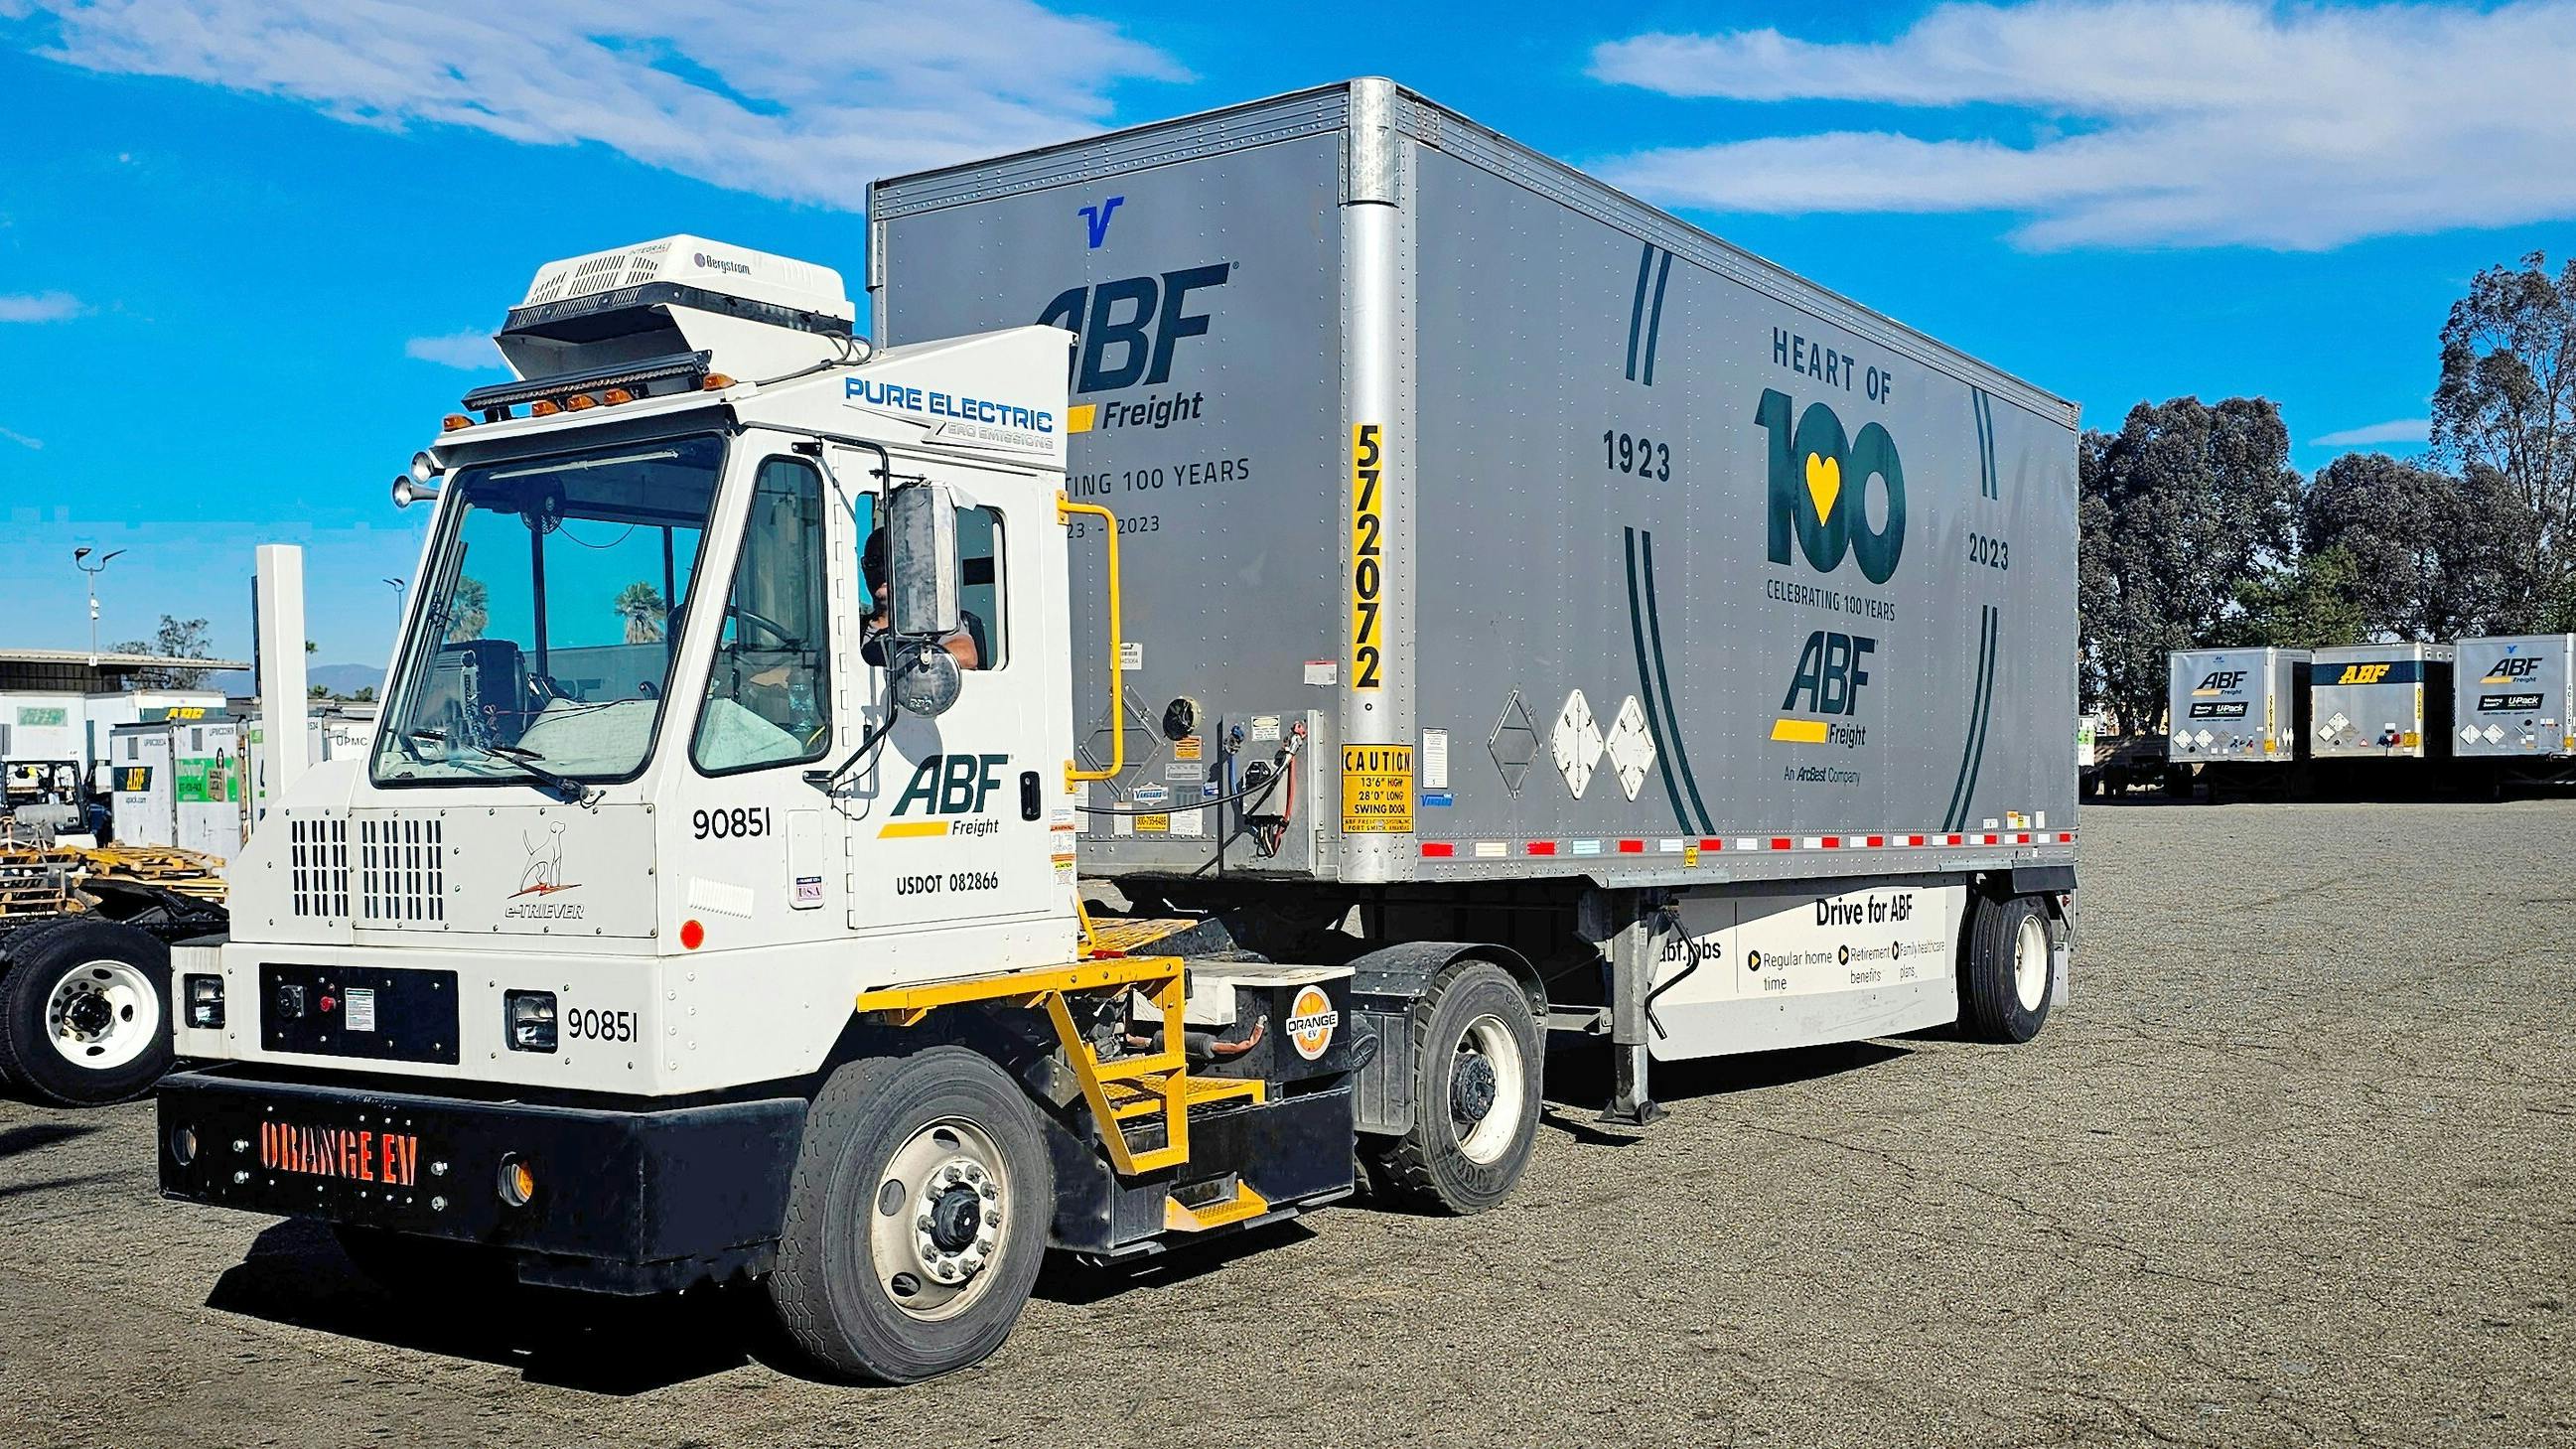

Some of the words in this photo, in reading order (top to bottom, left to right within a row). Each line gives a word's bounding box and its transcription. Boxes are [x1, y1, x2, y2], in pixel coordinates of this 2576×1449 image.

[706, 254, 752, 275] Bergstrom
[1772, 326, 1856, 391] HEART
[1865, 364, 1893, 405] OF
[845, 376, 923, 411] PURE
[929, 391, 1053, 433] ELECTRIC
[1102, 391, 1205, 430] Freight
[978, 426, 1054, 450] EMISSIONS
[1603, 429, 1671, 484] 1923
[1122, 468, 1164, 492] 100
[1173, 458, 1250, 488] YEARS
[1754, 386, 1907, 586] 100
[1117, 515, 1160, 534] 2023
[1355, 424, 1380, 688] 572072
[1968, 531, 2010, 572] 2023
[1767, 578, 1839, 612] CELEBRATING
[1843, 595, 1862, 615] 100
[1865, 598, 1895, 622] YEARS
[1781, 631, 1876, 716] ABF
[2338, 663, 2390, 684] ABF
[2486, 657, 2543, 677] ABF
[2196, 670, 2248, 690] ABF
[1828, 723, 1867, 749] Freight
[1345, 751, 1410, 773] CAUTION
[126, 768, 146, 791] ABF
[891, 753, 1009, 816] ABF
[1784, 766, 1795, 782] An
[1796, 767, 1826, 783] ArcBest
[1828, 768, 1861, 787] Company
[1386, 792, 1403, 801] LONG
[1355, 803, 1387, 814] SWING
[1388, 803, 1406, 814] DOOR
[692, 806, 772, 840] 90851
[951, 817, 1000, 837] Freight
[897, 874, 942, 896] USDOT
[948, 871, 999, 893] 082866
[504, 903, 585, 920] e-TRIEVER
[1816, 897, 1863, 927] Drive
[1867, 895, 1888, 924] for
[1890, 893, 1913, 922] ABF
[1764, 951, 1802, 970] Regular
[1804, 950, 1833, 965] home
[1850, 946, 1891, 962] Retirement
[1899, 942, 1918, 959] Family
[1918, 939, 1945, 954] healthcare
[1764, 976, 1788, 991] time
[1850, 967, 1882, 984] benefits
[567, 1007, 638, 1043] 90851
[1288, 1014, 1337, 1033] ORANGE
[1308, 1029, 1319, 1039] EV
[260, 1121, 373, 1182] ORANGE
[381, 1133, 417, 1187] EV
